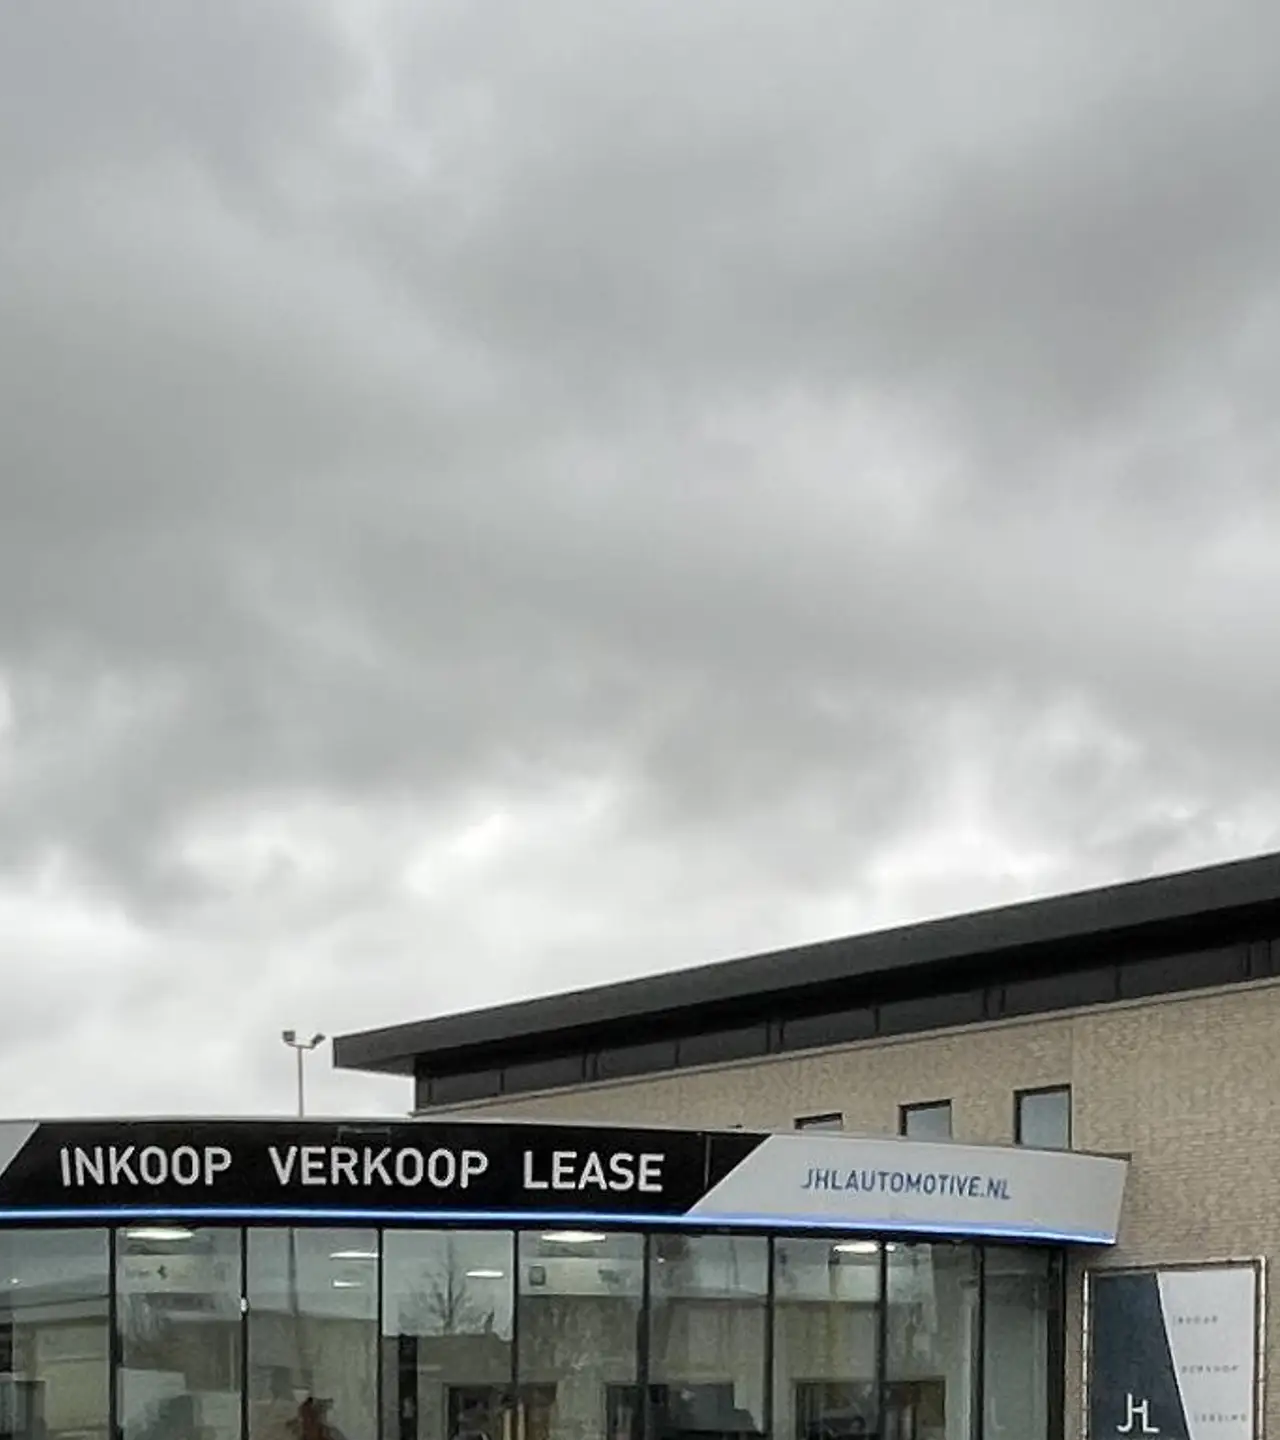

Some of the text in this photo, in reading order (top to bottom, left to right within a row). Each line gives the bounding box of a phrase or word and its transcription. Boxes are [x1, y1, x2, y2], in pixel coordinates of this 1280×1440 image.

[59, 1145, 665, 1193] INKOOP VERKOOP LEASE
[800, 1167, 1012, 1200] JHLAUTOMOTIVE.NL
